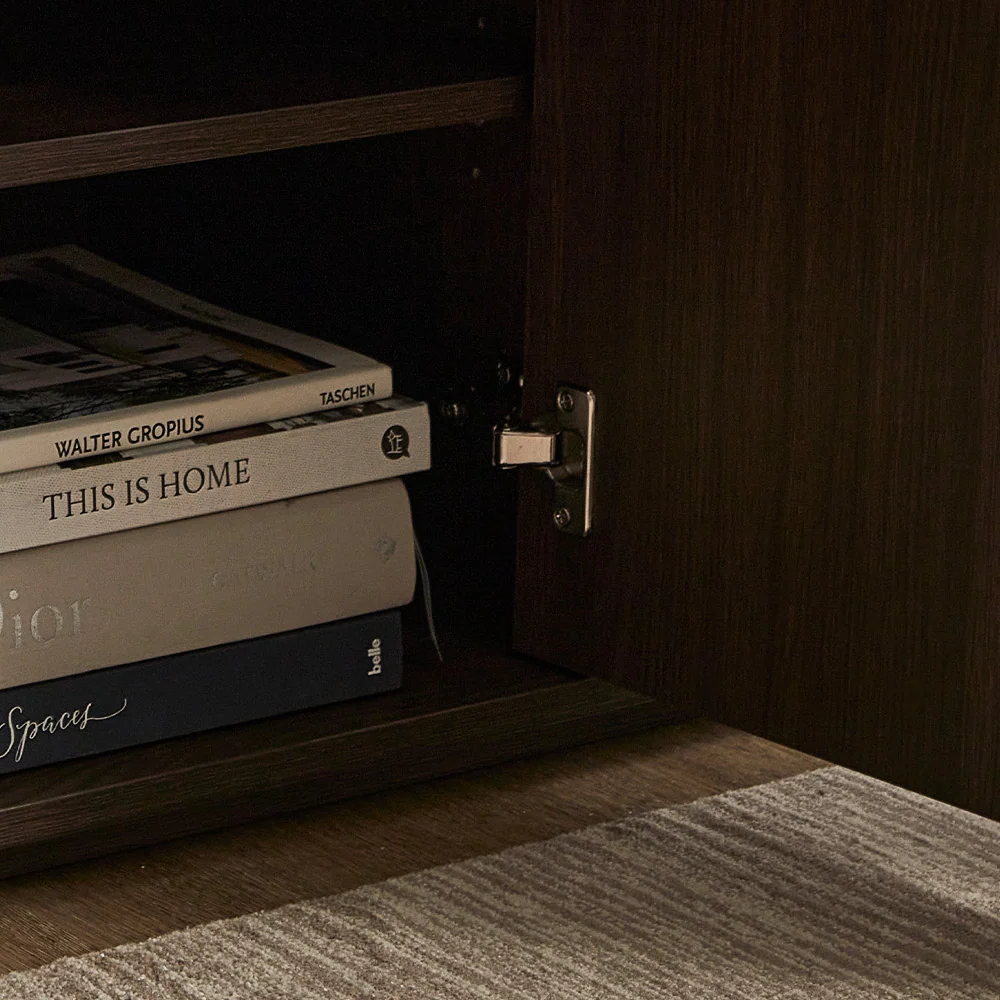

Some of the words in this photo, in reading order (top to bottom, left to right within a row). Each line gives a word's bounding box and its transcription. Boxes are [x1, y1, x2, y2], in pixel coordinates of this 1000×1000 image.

[319, 382, 376, 407] TASCHEN
[55, 430, 122, 458] WALTER
[127, 414, 205, 445] GROPIUS
[42, 482, 117, 521] THIS
[125, 475, 151, 506] IS
[159, 457, 252, 501] HOME
[367, 637, 382, 677] belle
